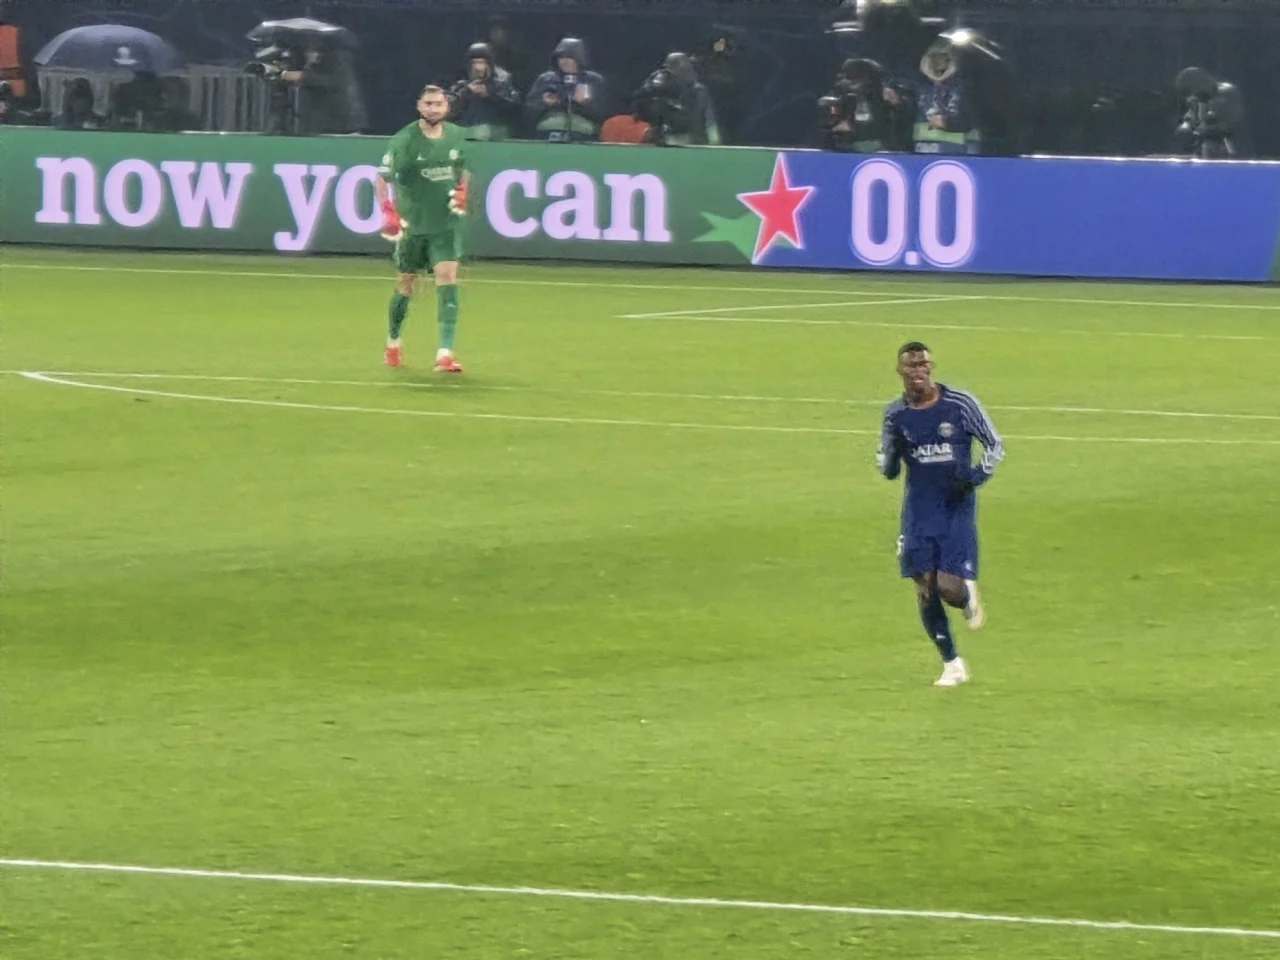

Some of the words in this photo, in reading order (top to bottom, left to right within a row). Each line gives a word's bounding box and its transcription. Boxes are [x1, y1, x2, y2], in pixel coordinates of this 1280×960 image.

[34, 156, 253, 230] now
[274, 162, 393, 252] yo
[486, 168, 672, 243] can
[851, 158, 975, 266] 0.0
